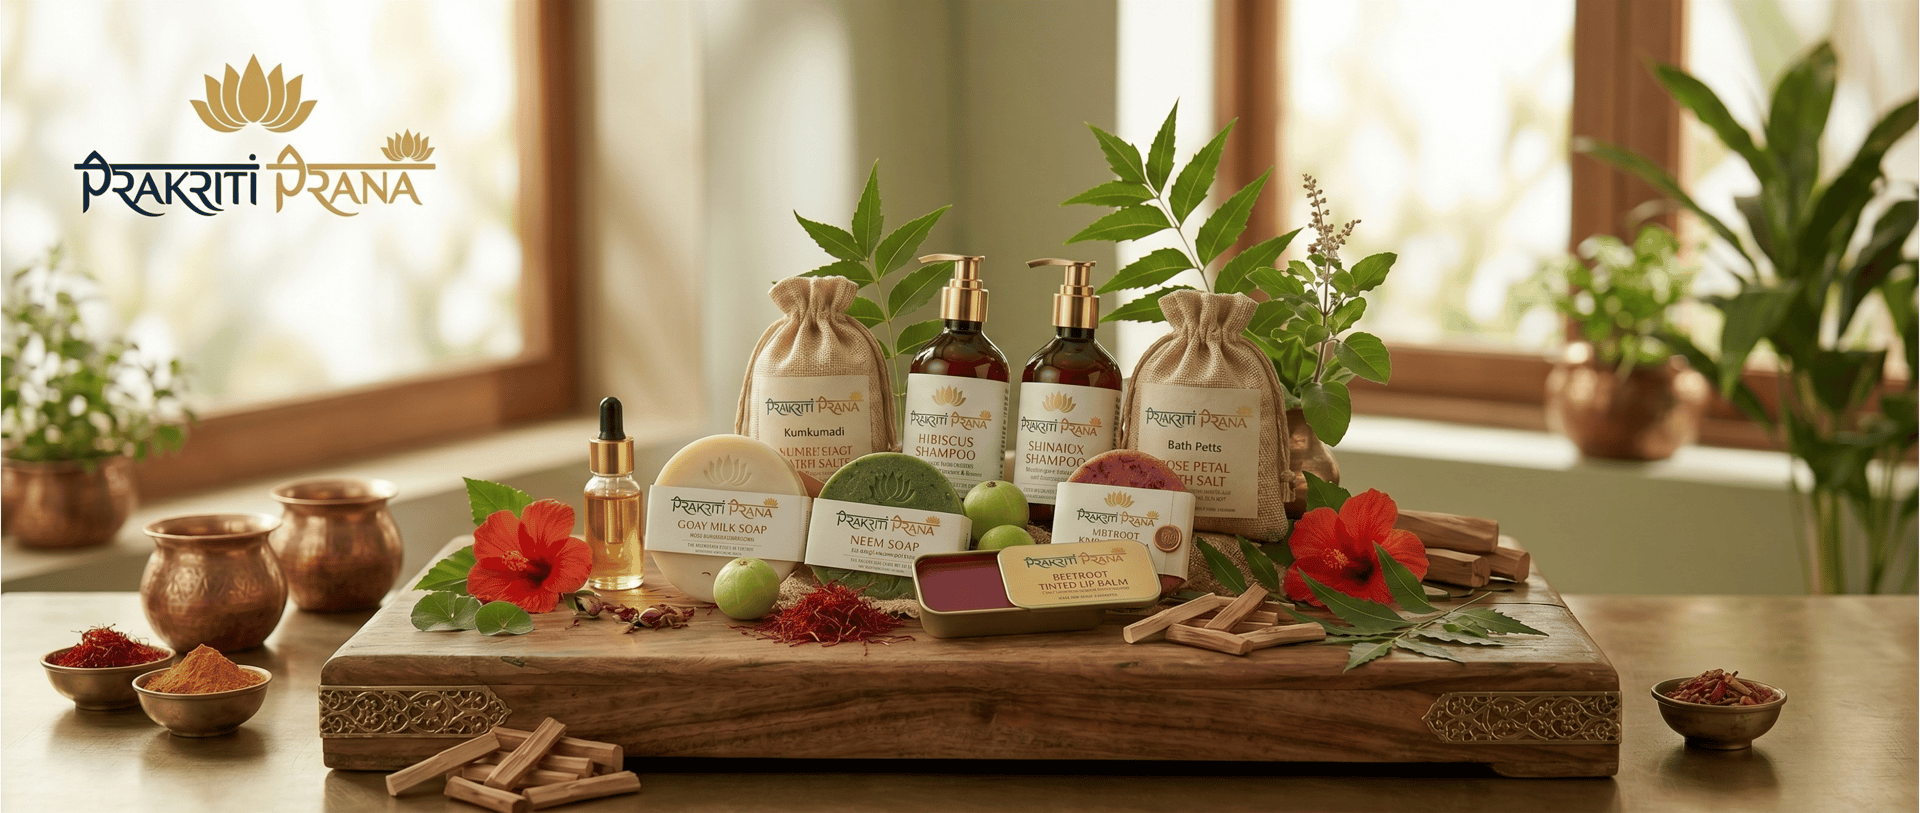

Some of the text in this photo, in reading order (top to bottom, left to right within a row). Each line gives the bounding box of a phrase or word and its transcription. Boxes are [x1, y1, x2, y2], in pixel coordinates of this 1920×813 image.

[816, 396, 864, 415] PRANA
[951, 411, 992, 430] PRANA
[1060, 418, 1102, 437] PRANA
[1198, 409, 1253, 431] PRANA
[784, 427, 845, 437] Kumkumadi
[918, 434, 974, 448] HIBISCUS
[1168, 440, 1222, 453] Bath Petts
[915, 446, 976, 460] SHAMPOO
[1162, 460, 1231, 474] OSE PETAL
[1196, 475, 1227, 487] SALT
[728, 498, 779, 519] PRANA
[677, 519, 768, 535] GOAY MILK SOAP
[890, 515, 941, 537] PRANA
[850, 535, 920, 552] NEEM SOAP
[1052, 570, 1108, 581] BEETROOT
[1038, 581, 1077, 591] TINTED
[1079, 580, 1095, 589] LIP
[1097, 578, 1129, 587] BALM
